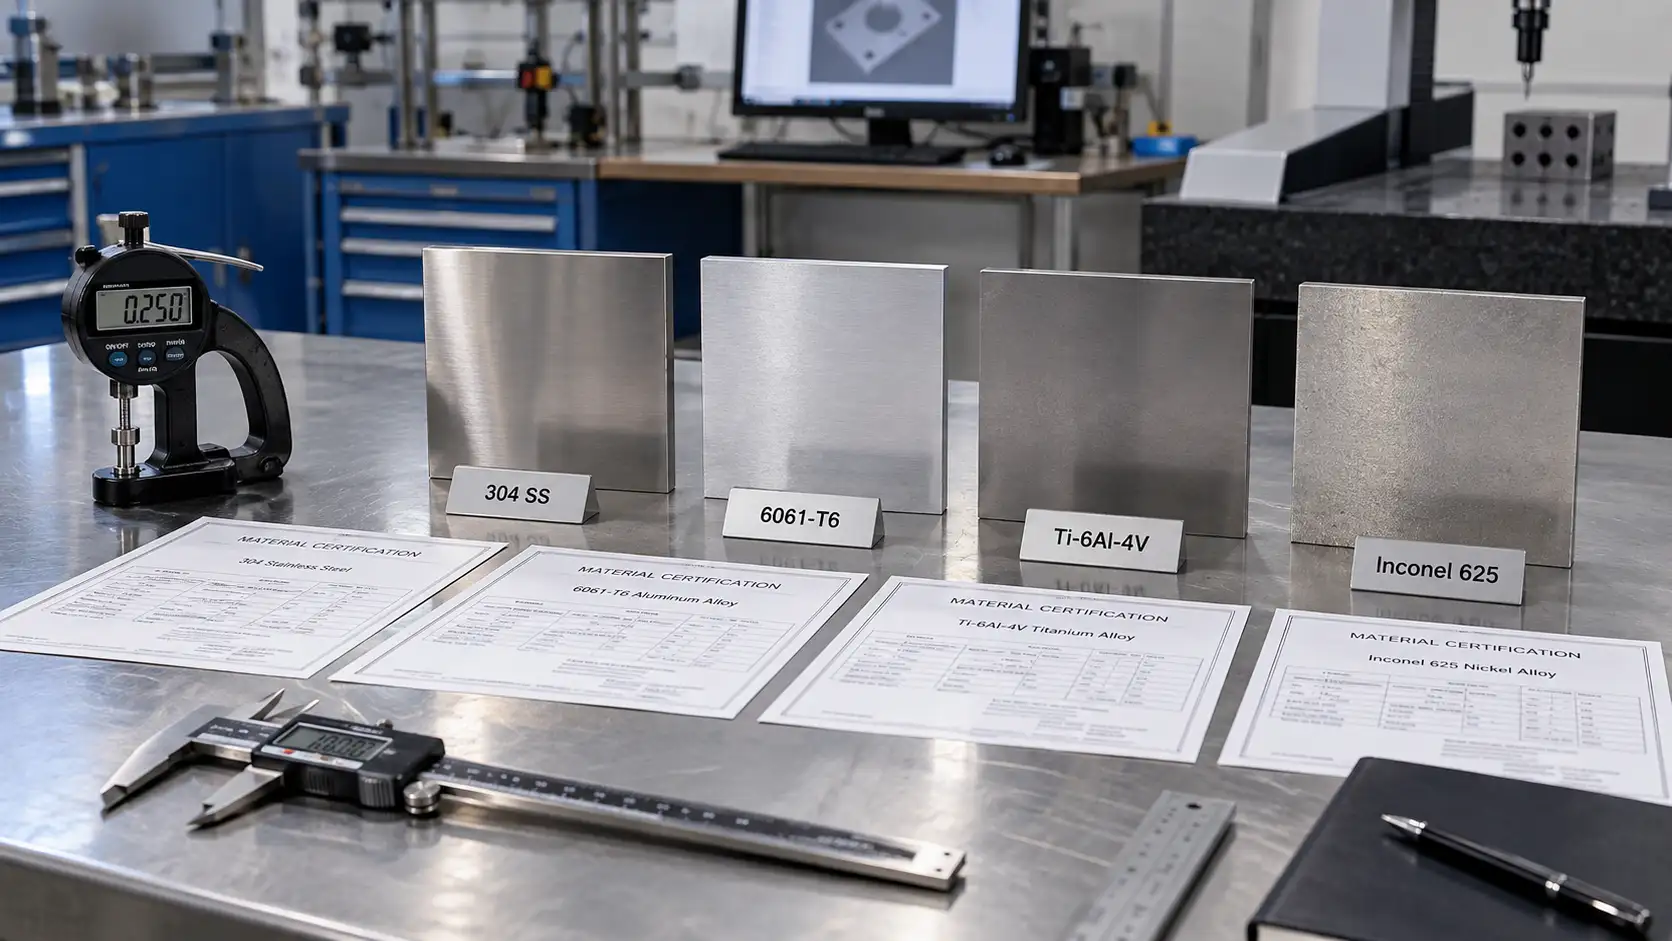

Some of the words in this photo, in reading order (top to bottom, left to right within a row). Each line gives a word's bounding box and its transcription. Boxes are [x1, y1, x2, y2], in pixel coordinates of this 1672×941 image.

[124, 293, 183, 324] 0.250
[484, 484, 520, 503] 304
[525, 487, 551, 505] SS
[760, 506, 841, 529] 6061-T6
[237, 536, 307, 548] MATERIAL
[311, 542, 422, 558] CERTIFICATION
[1054, 527, 1150, 553] Ti-6Al-4V
[239, 557, 261, 565] 304
[263, 559, 318, 571] Stainless
[320, 565, 352, 573] Steel
[1376, 555, 1453, 580] Inconel
[1459, 563, 1499, 584] 625
[577, 566, 655, 579] MATERIAL
[660, 573, 782, 590] CERTIFICATION
[573, 585, 630, 597] 6061-T6
[632, 591, 699, 604] Aluminum
[702, 597, 738, 608] Alloy
[950, 597, 1033, 611] MATERIAL
[1039, 605, 1169, 623] CERTIFICATION
[959, 618, 1028, 632] Ti-6Al-4V
[1032, 625, 1094, 638] Titanium
[1098, 631, 1136, 642] Alloy
[1350, 632, 1439, 647] MATERIAL
[1445, 641, 1581, 659] CERTIFICATION
[1368, 654, 1425, 666] Inconel
[1429, 660, 1459, 669] 625
[1464, 663, 1512, 674] Nickel
[1517, 667, 1557, 680] Alloy
